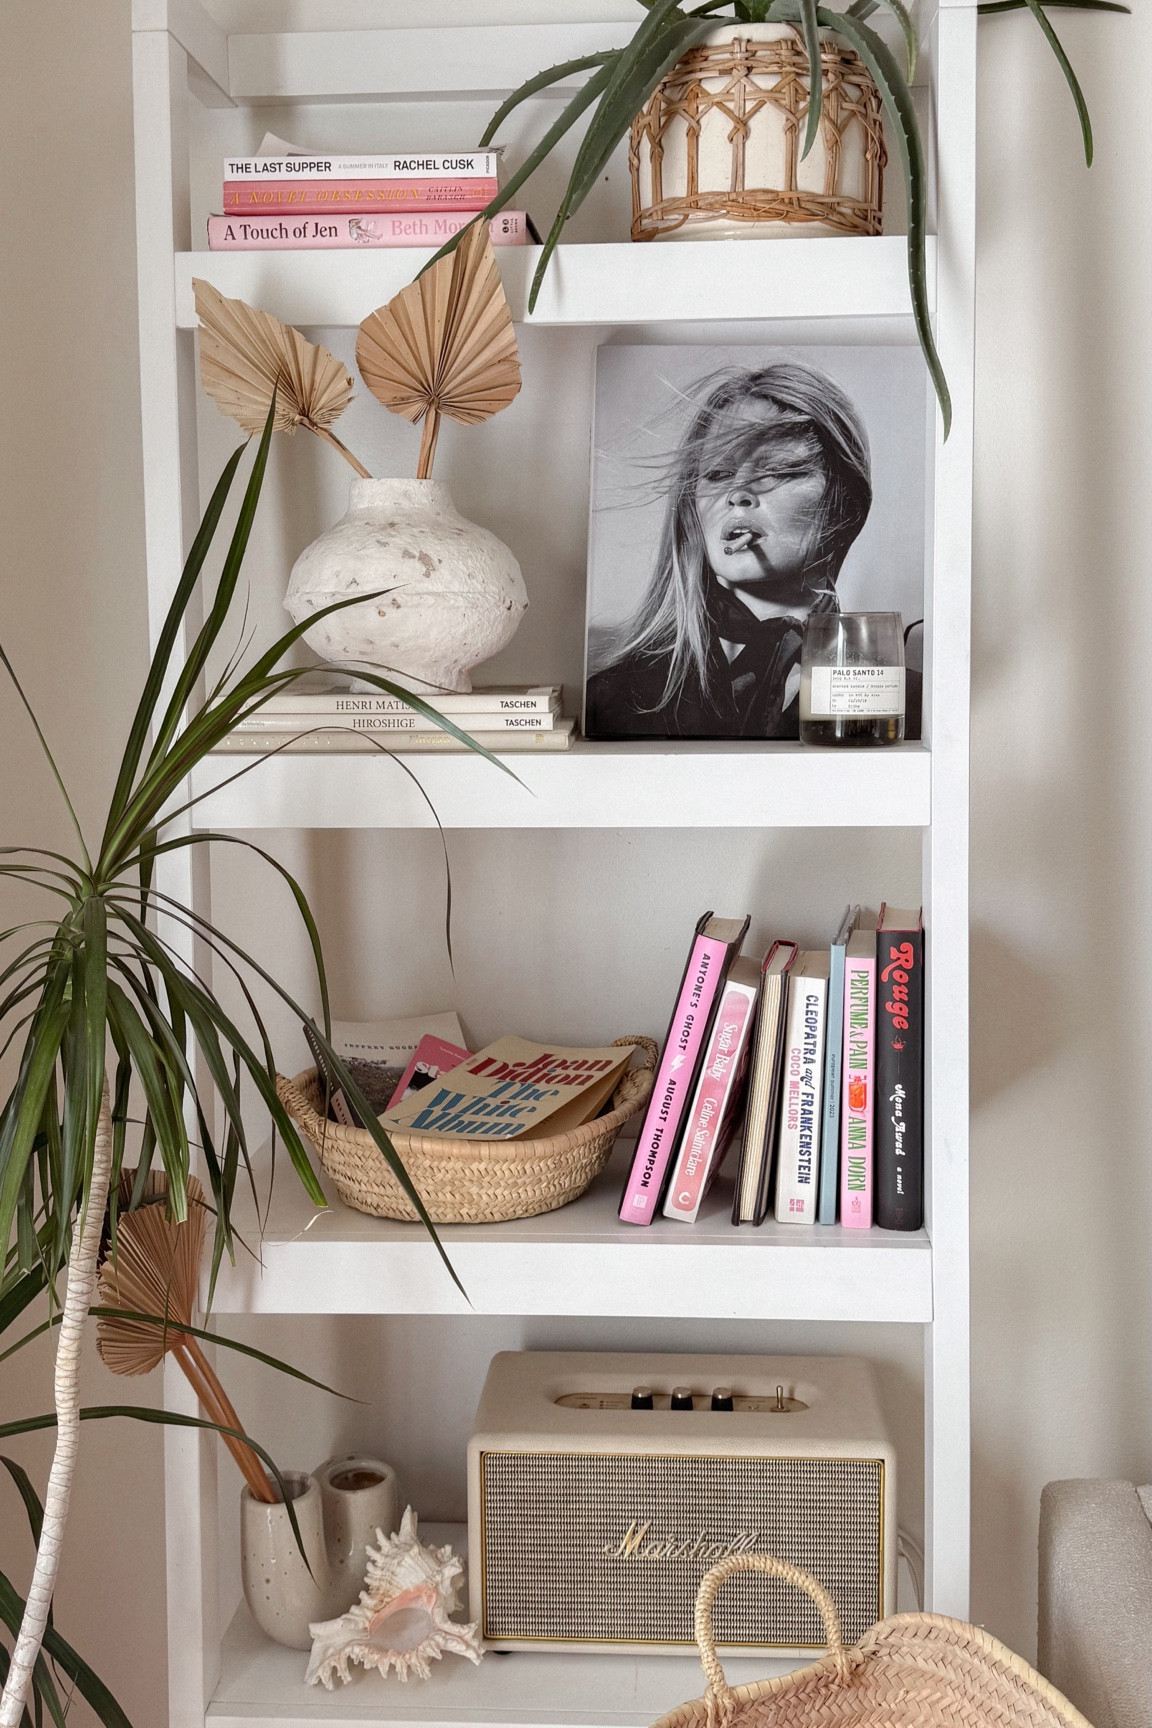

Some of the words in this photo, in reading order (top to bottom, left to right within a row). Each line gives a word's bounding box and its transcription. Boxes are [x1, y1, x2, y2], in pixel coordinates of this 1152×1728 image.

[228, 163, 252, 174] THE
[254, 163, 283, 173] LAST
[286, 162, 332, 172] SUPPER
[394, 160, 440, 170] RACHEL
[442, 158, 474, 170] CUSK
[230, 192, 240, 204] A
[249, 191, 306, 204] NOVEL
[316, 188, 420, 202] OBSESSION
[224, 224, 236, 240] A
[240, 222, 288, 240] Touch
[292, 222, 309, 238] of
[312, 222, 338, 238] Jen
[391, 220, 428, 236] Beth
[336, 700, 372, 710] HENRI
[500, 700, 537, 708] TASCHEN
[352, 718, 416, 728] HIROSHIGE
[690, 953, 711, 1008] ANYONE'S
[880, 942, 914, 1030] Rouge
[850, 970, 869, 1029] PERFUME
[678, 1014, 694, 1051] GHOST
[717, 1022, 738, 1055] Sugar
[802, 994, 819, 1064] CLEOPATRA
[464, 1056, 594, 1086] Didion
[512, 1052, 615, 1072] Joan
[708, 1053, 730, 1082] Baby
[790, 1048, 801, 1076] COCO
[849, 1040, 868, 1070] PAIN
[486, 1080, 560, 1102] The
[800, 1068, 816, 1090] and
[426, 1086, 537, 1118] White
[658, 1078, 677, 1122] AUGUST
[698, 1097, 718, 1129] Celine
[788, 1080, 800, 1130] MELLORS
[889, 1084, 906, 1117] Mona
[391, 1109, 526, 1136] Album
[798, 1092, 814, 1184] FRANKENSTEIN
[848, 1116, 867, 1150] ANNA
[891, 1116, 906, 1156] Awad
[640, 1128, 664, 1188] THOMPSON
[684, 1129, 710, 1176] Saintclare
[848, 1156, 866, 1191] DORN
[896, 1174, 904, 1194] novel
[604, 1519, 760, 1560] Marshall
